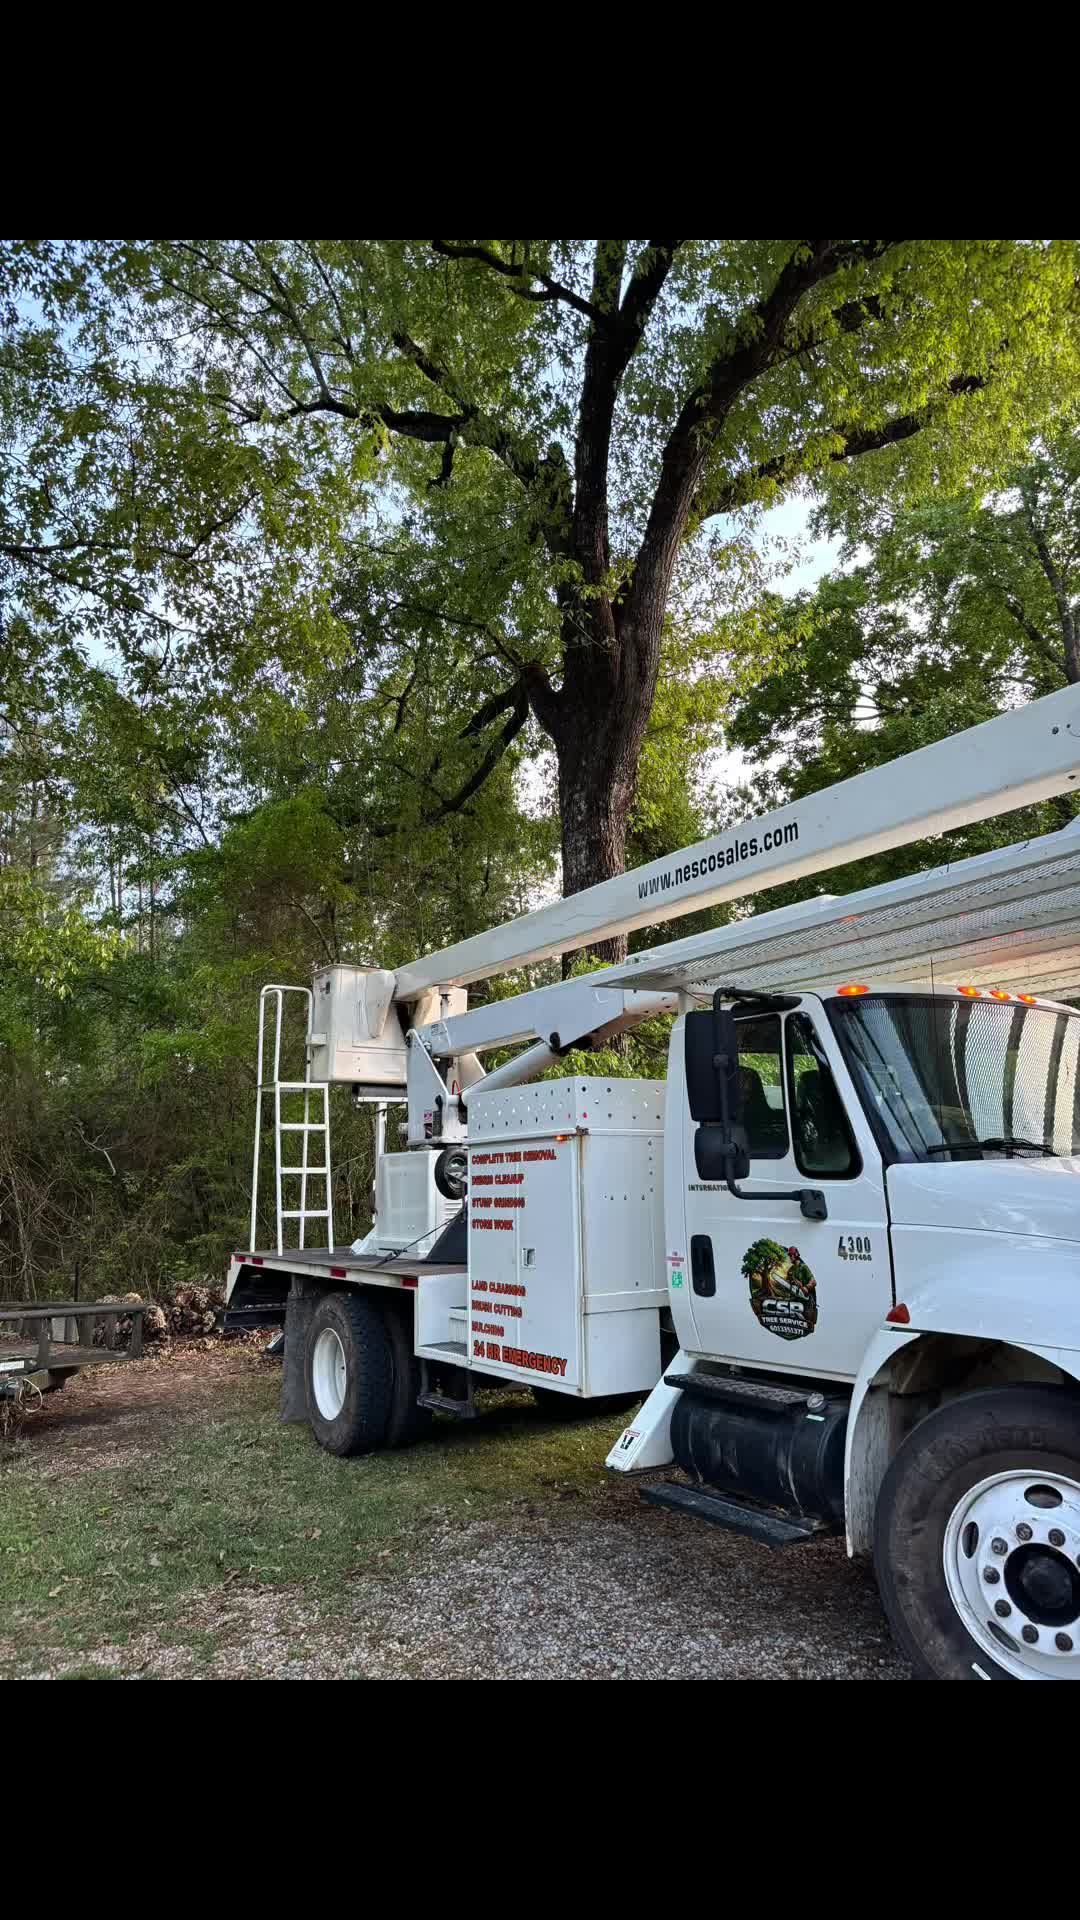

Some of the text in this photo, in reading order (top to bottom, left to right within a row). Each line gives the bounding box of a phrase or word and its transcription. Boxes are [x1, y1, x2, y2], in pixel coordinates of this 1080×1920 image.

[638, 822, 799, 899] www.nescosales.com
[472, 1149, 557, 1164] COMPLETE TREE REMOVAL
[495, 1174, 524, 1184] CLEANUP
[472, 1197, 492, 1208] STUMP
[472, 1219, 513, 1231] STORM WORK
[838, 1236, 871, 1254] 4300
[472, 1280, 526, 1296] LAND CLEARING
[493, 1303, 522, 1318] CUTTING
[762, 1299, 806, 1319] CSR
[472, 1321, 504, 1337] MULCHING
[780, 1317, 808, 1328] SERVICE
[473, 1340, 568, 1376] 24 HR EMERGENCY
